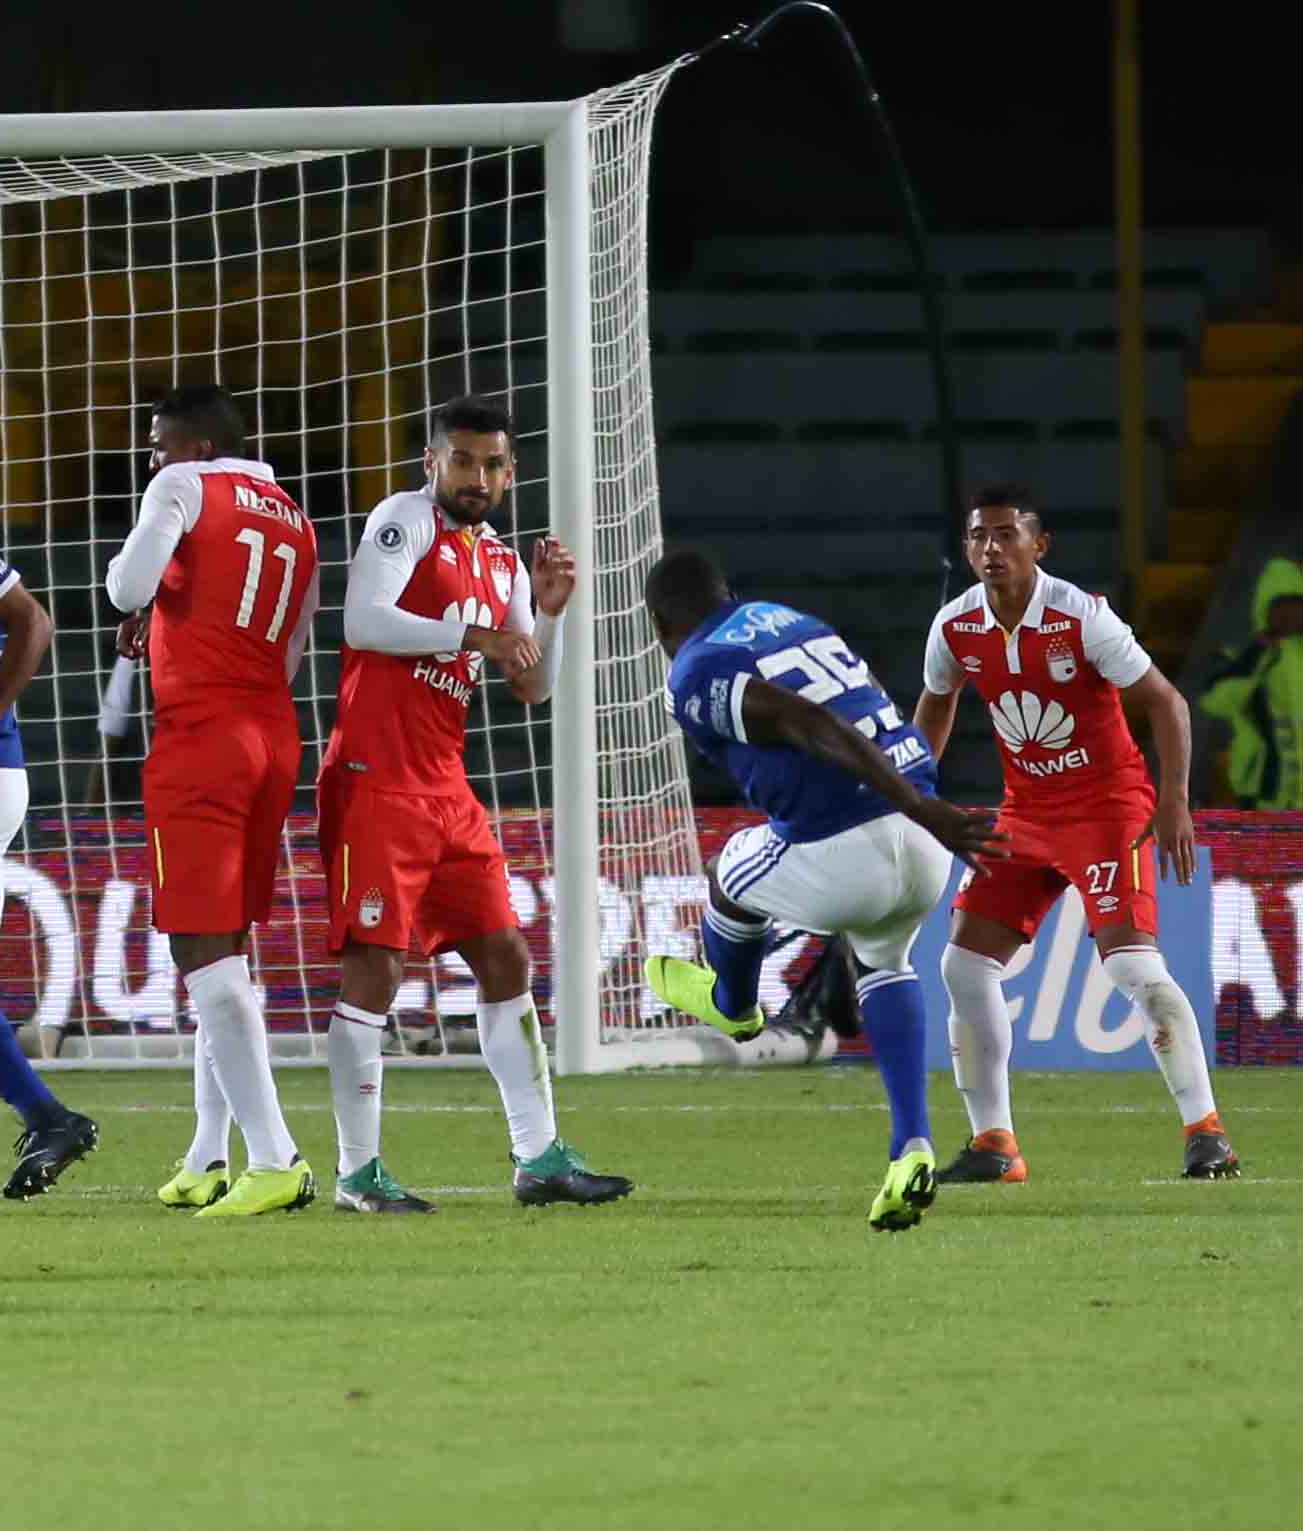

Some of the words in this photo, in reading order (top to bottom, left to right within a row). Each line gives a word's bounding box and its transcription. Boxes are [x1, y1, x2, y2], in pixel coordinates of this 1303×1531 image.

[235, 528, 296, 643] 11
[413, 661, 473, 708] HUAWE
[1012, 747, 1090, 777] AWEI
[1087, 861, 1119, 894] 27
